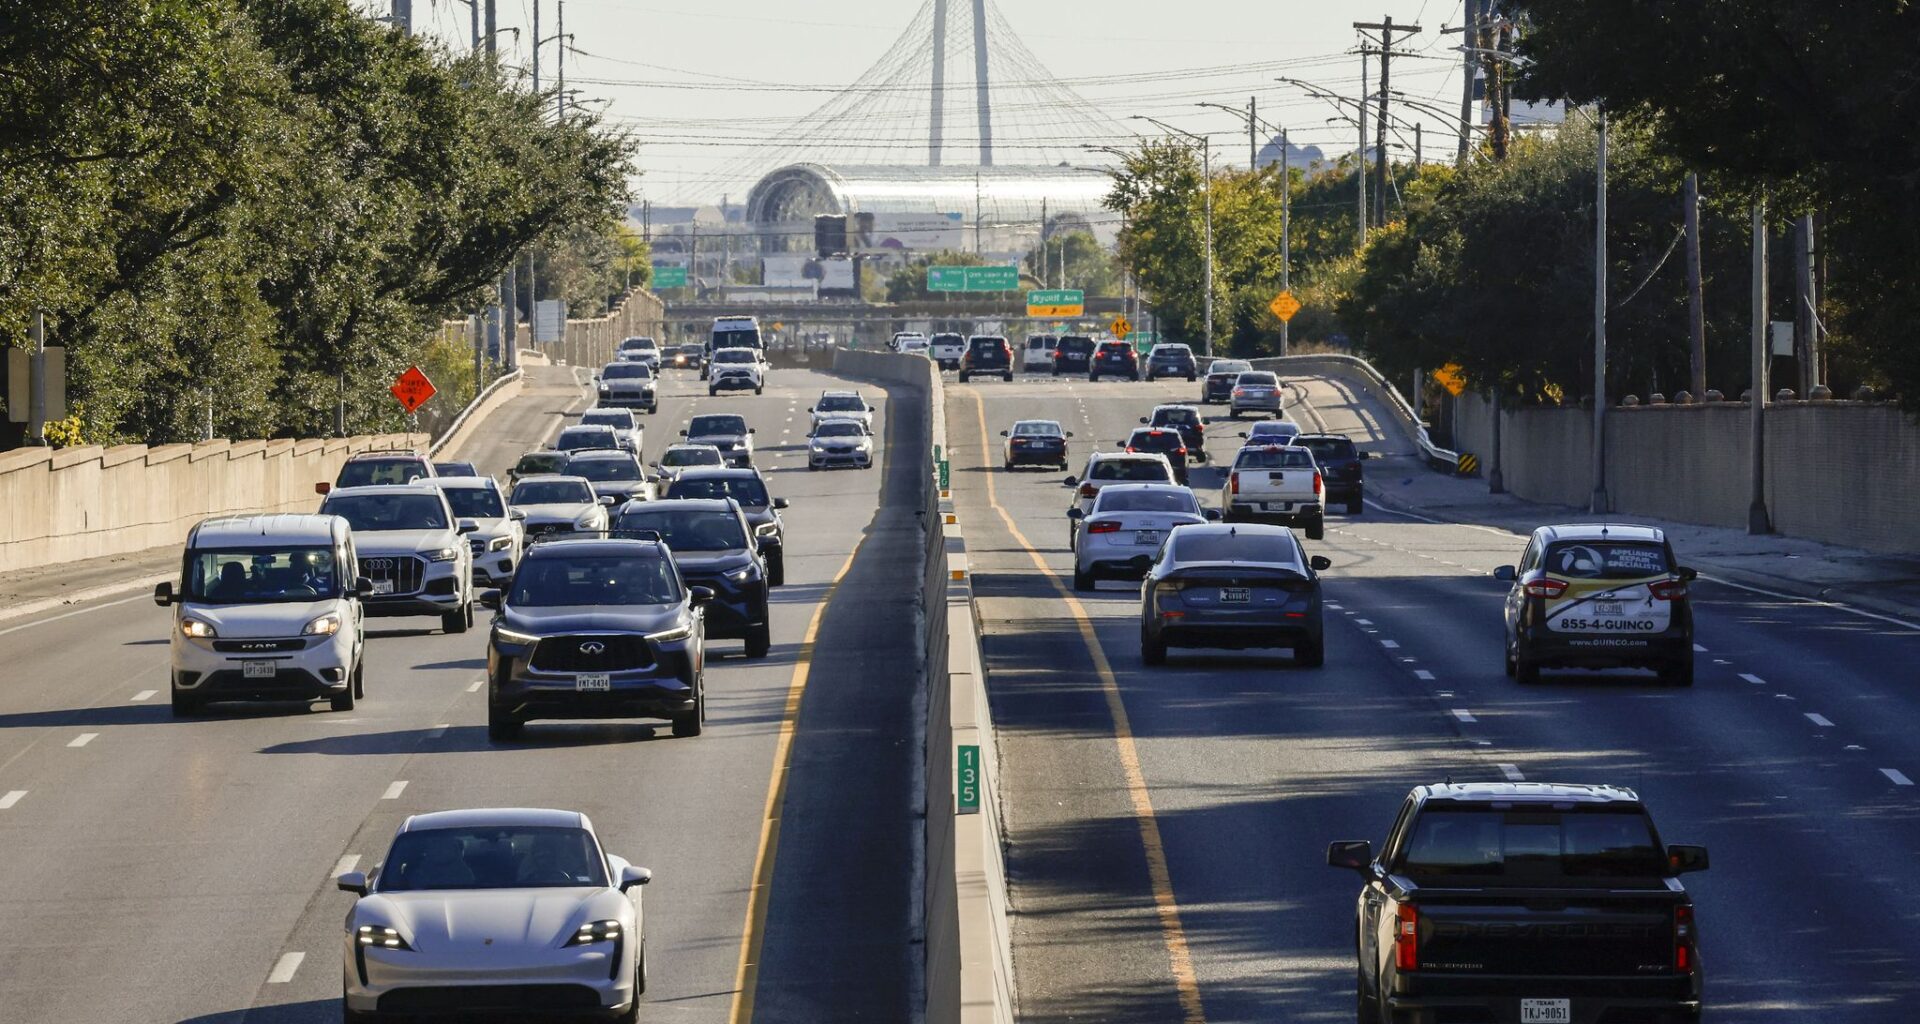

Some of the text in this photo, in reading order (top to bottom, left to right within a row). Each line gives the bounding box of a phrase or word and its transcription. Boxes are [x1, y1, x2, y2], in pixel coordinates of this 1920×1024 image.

[1610, 549, 1659, 559] APPLIANCE
[1620, 555, 1650, 564] REPAIR
[1607, 560, 1662, 571] SPECIALISTS
[1561, 618, 1654, 631] 855-4-GUINCO
[1568, 638, 1648, 647] www.GUINCO.com
[963, 750, 975, 802] 135
[1434, 922, 1655, 937] CHEVROLET
